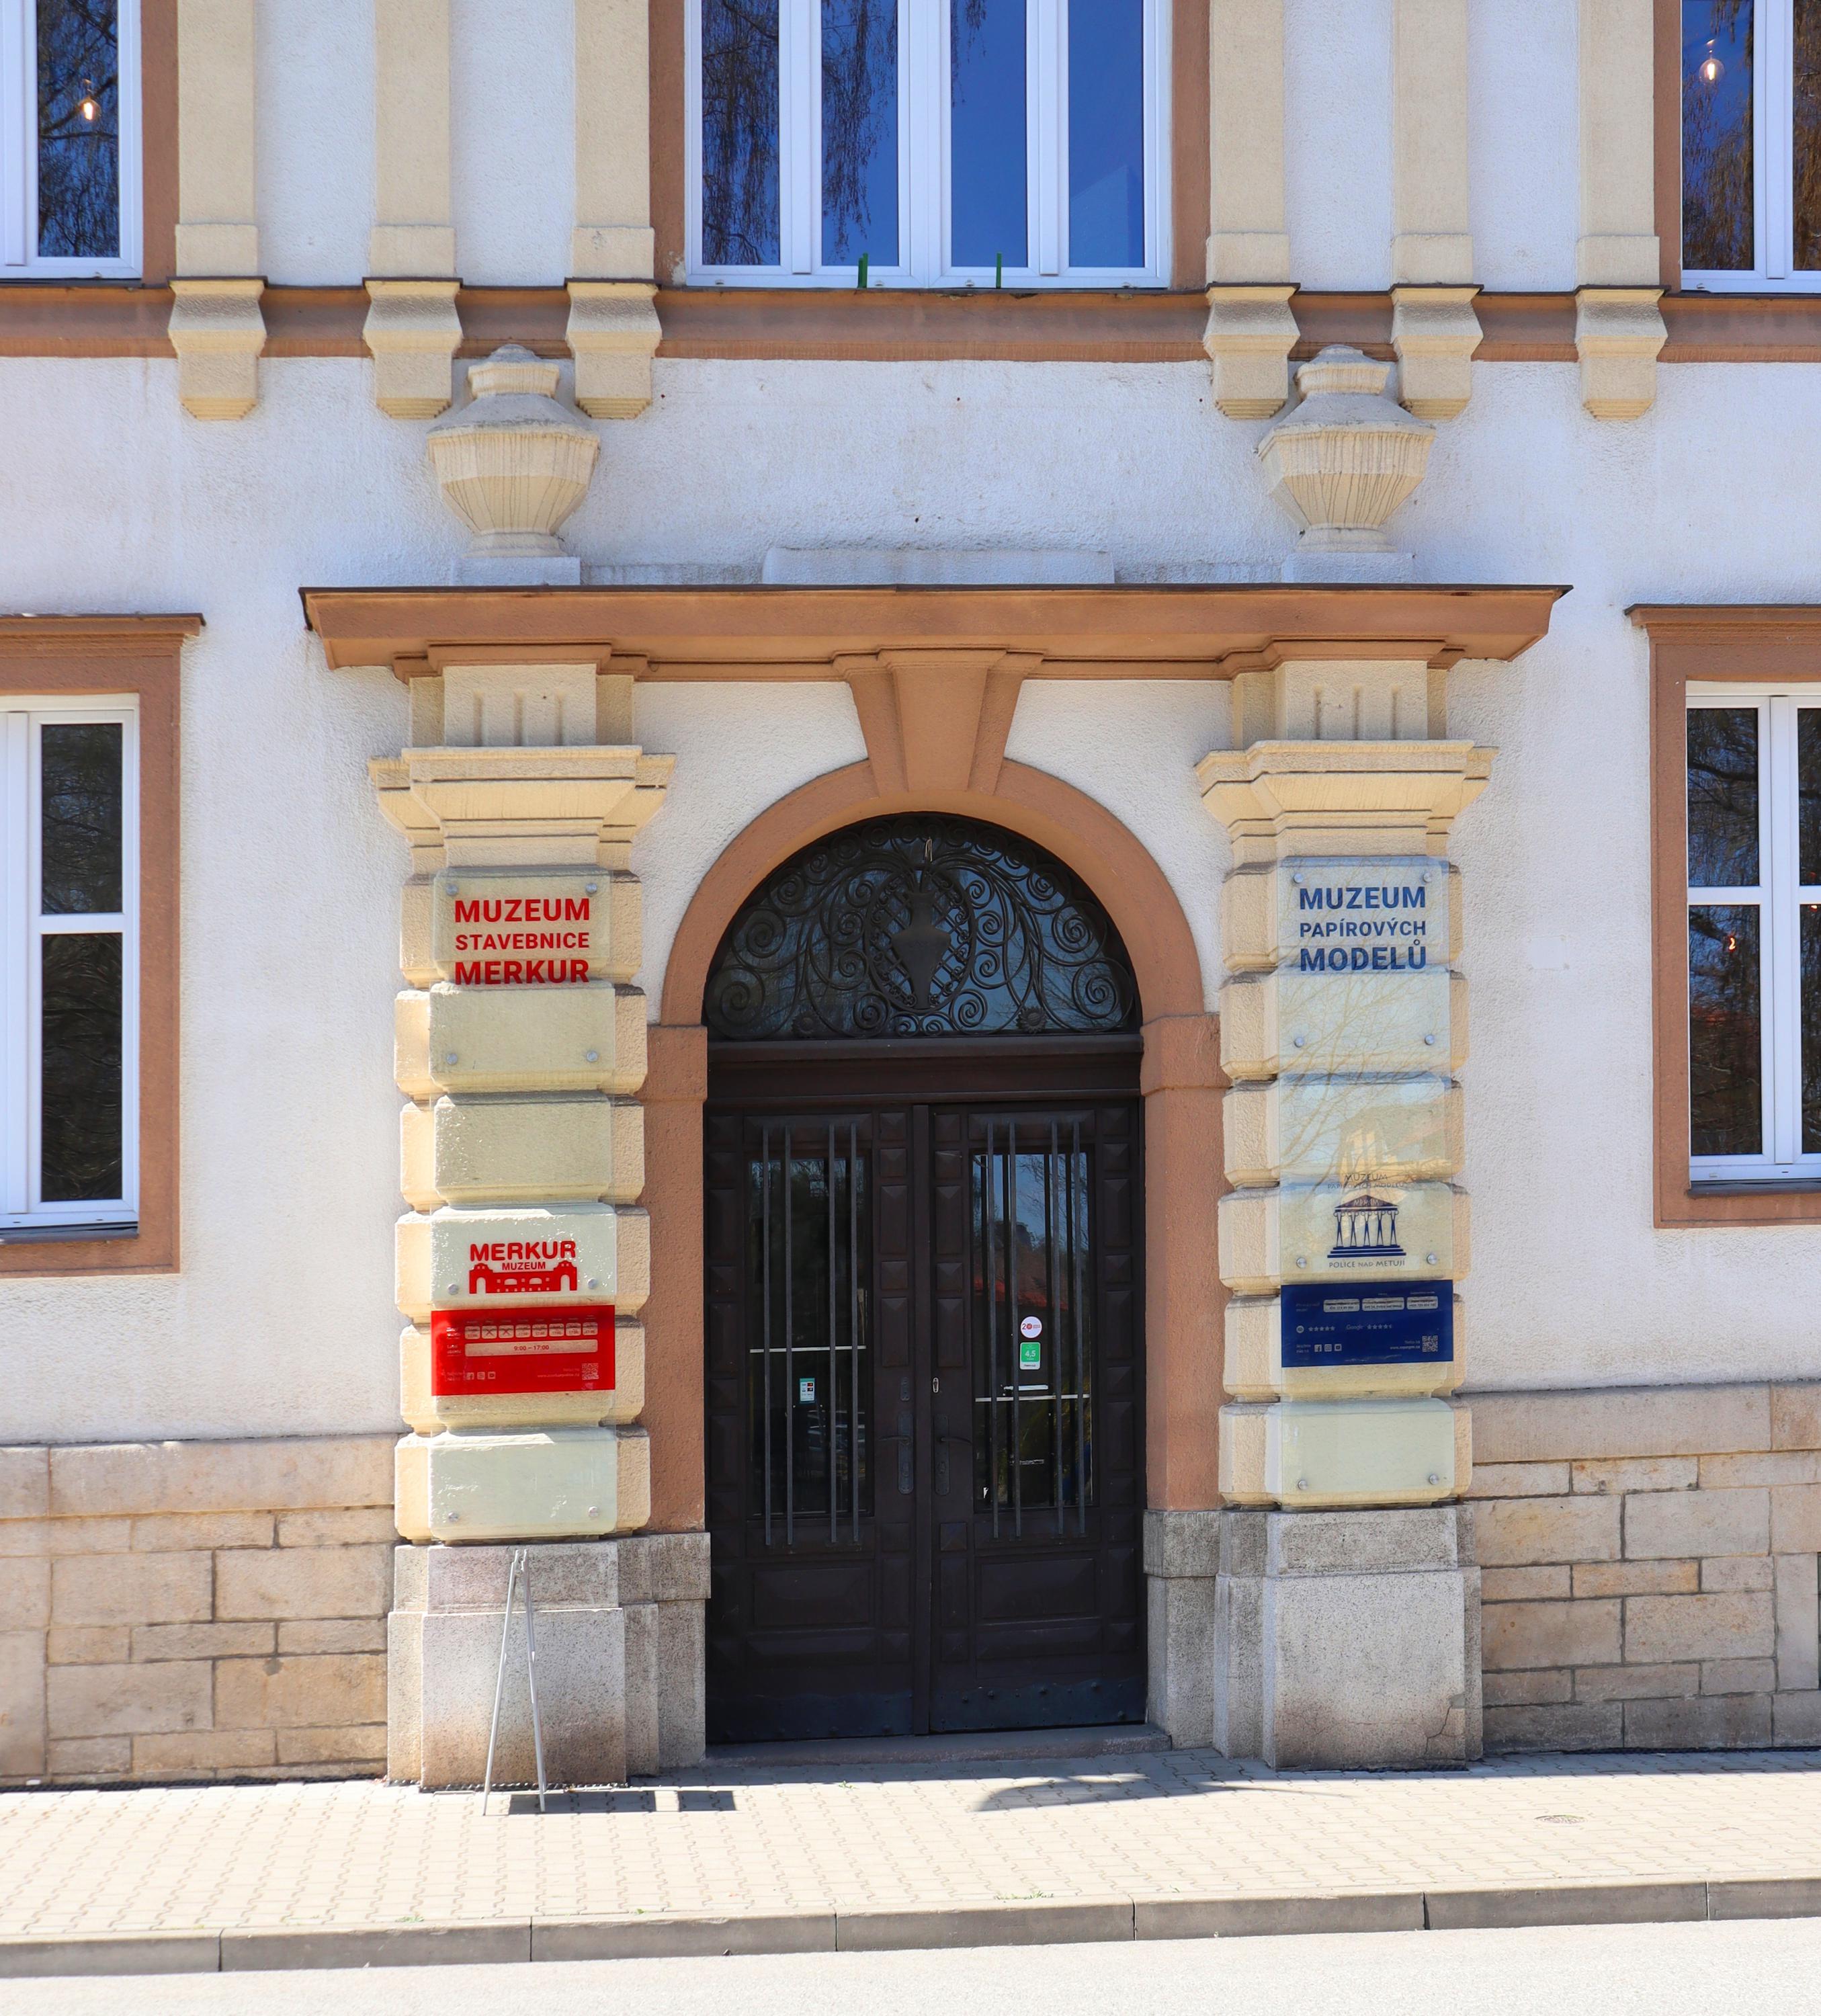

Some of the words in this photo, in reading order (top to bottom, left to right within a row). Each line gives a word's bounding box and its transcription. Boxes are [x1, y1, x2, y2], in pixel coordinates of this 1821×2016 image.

[1300, 886, 1425, 910] MUZEUM
[454, 898, 590, 923] MUZEUM
[1300, 917, 1426, 938] PAPÍROVÝCH
[455, 932, 590, 950] STAVEBNICE
[1300, 939, 1427, 972] MODELŮ
[455, 960, 589, 985] MERKUR
[1344, 1173, 1388, 1182] MUZEUM
[470, 1241, 576, 1261] MERKUR
[502, 1261, 546, 1271] MUZEUM
[1375, 1258, 1405, 1267] METUJÍ
